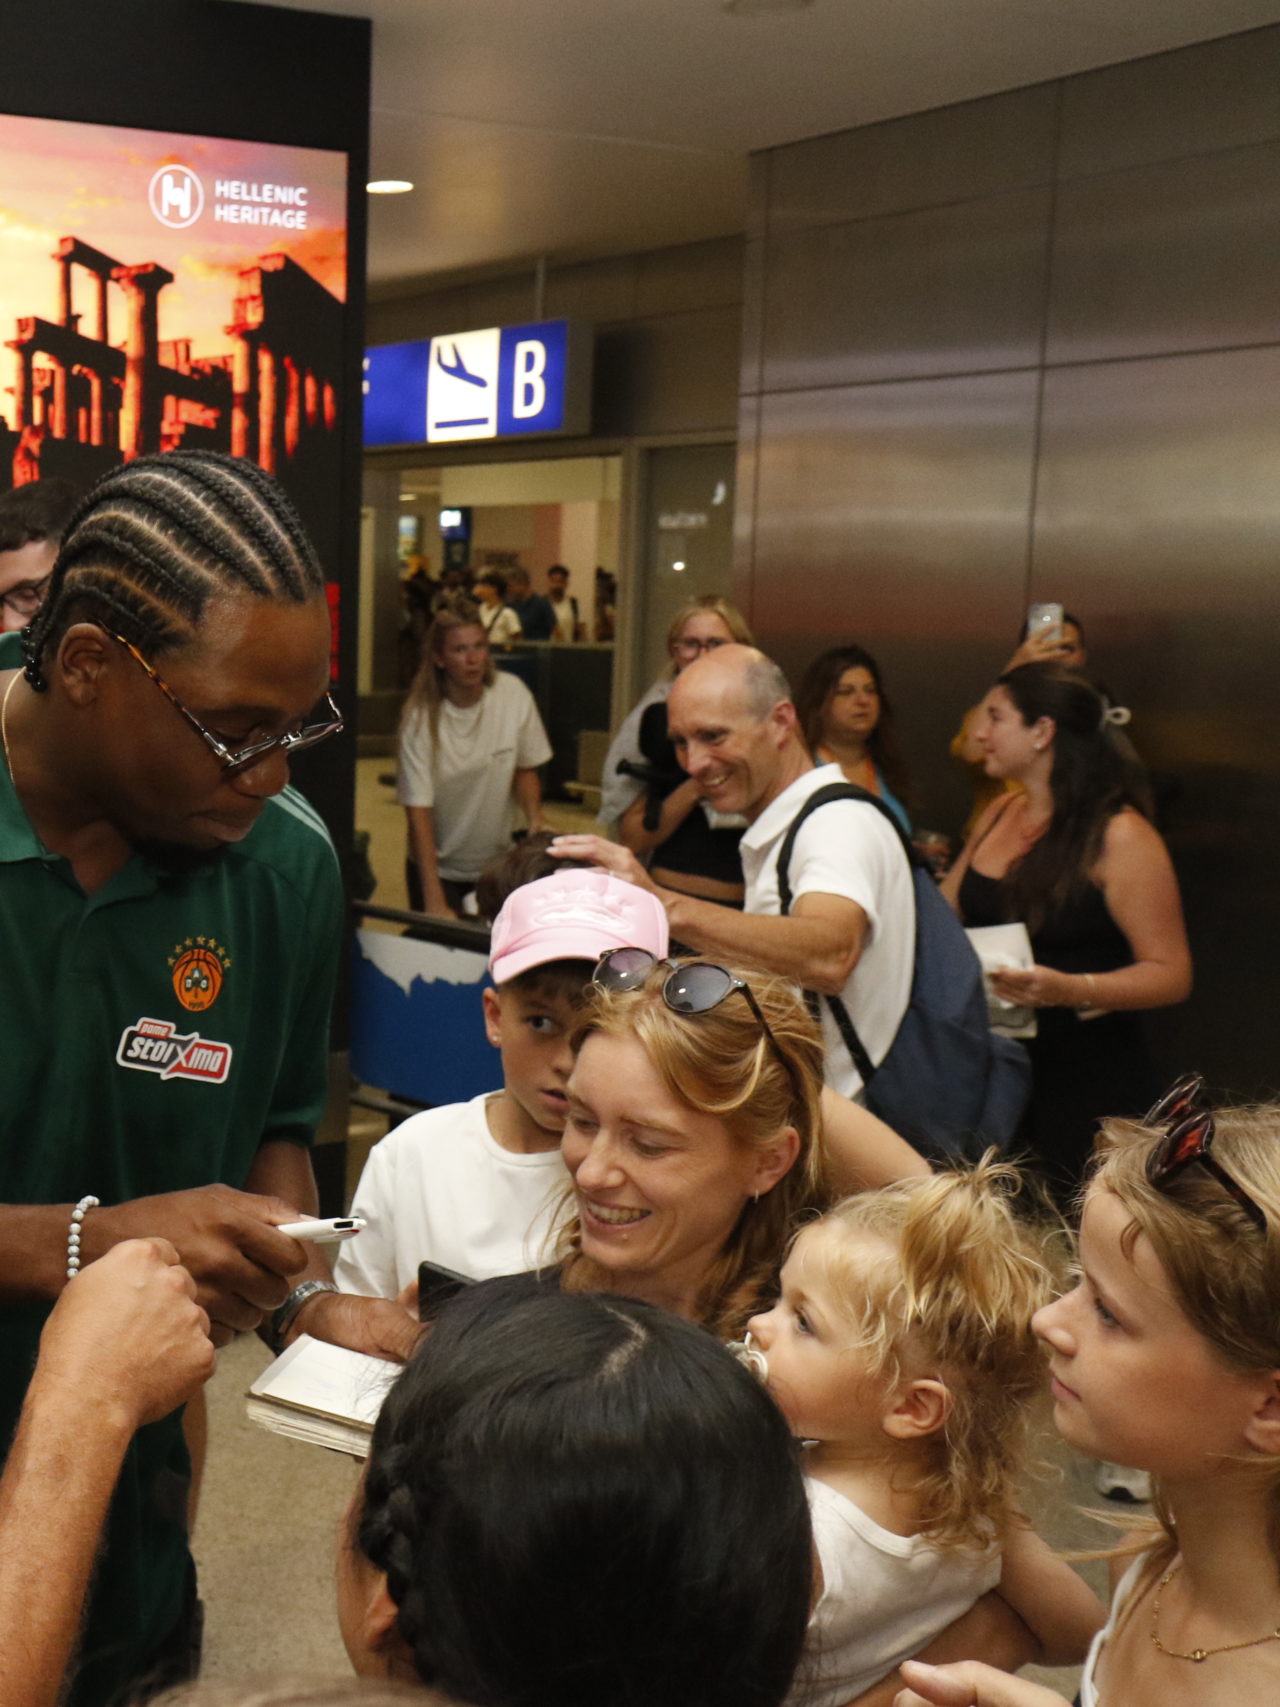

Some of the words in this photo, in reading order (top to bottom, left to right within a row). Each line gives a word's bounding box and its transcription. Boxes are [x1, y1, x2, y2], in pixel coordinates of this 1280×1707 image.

[214, 179, 309, 207] HELLENIC
[214, 204, 308, 230] HERITAGE
[512, 339, 547, 419] B
